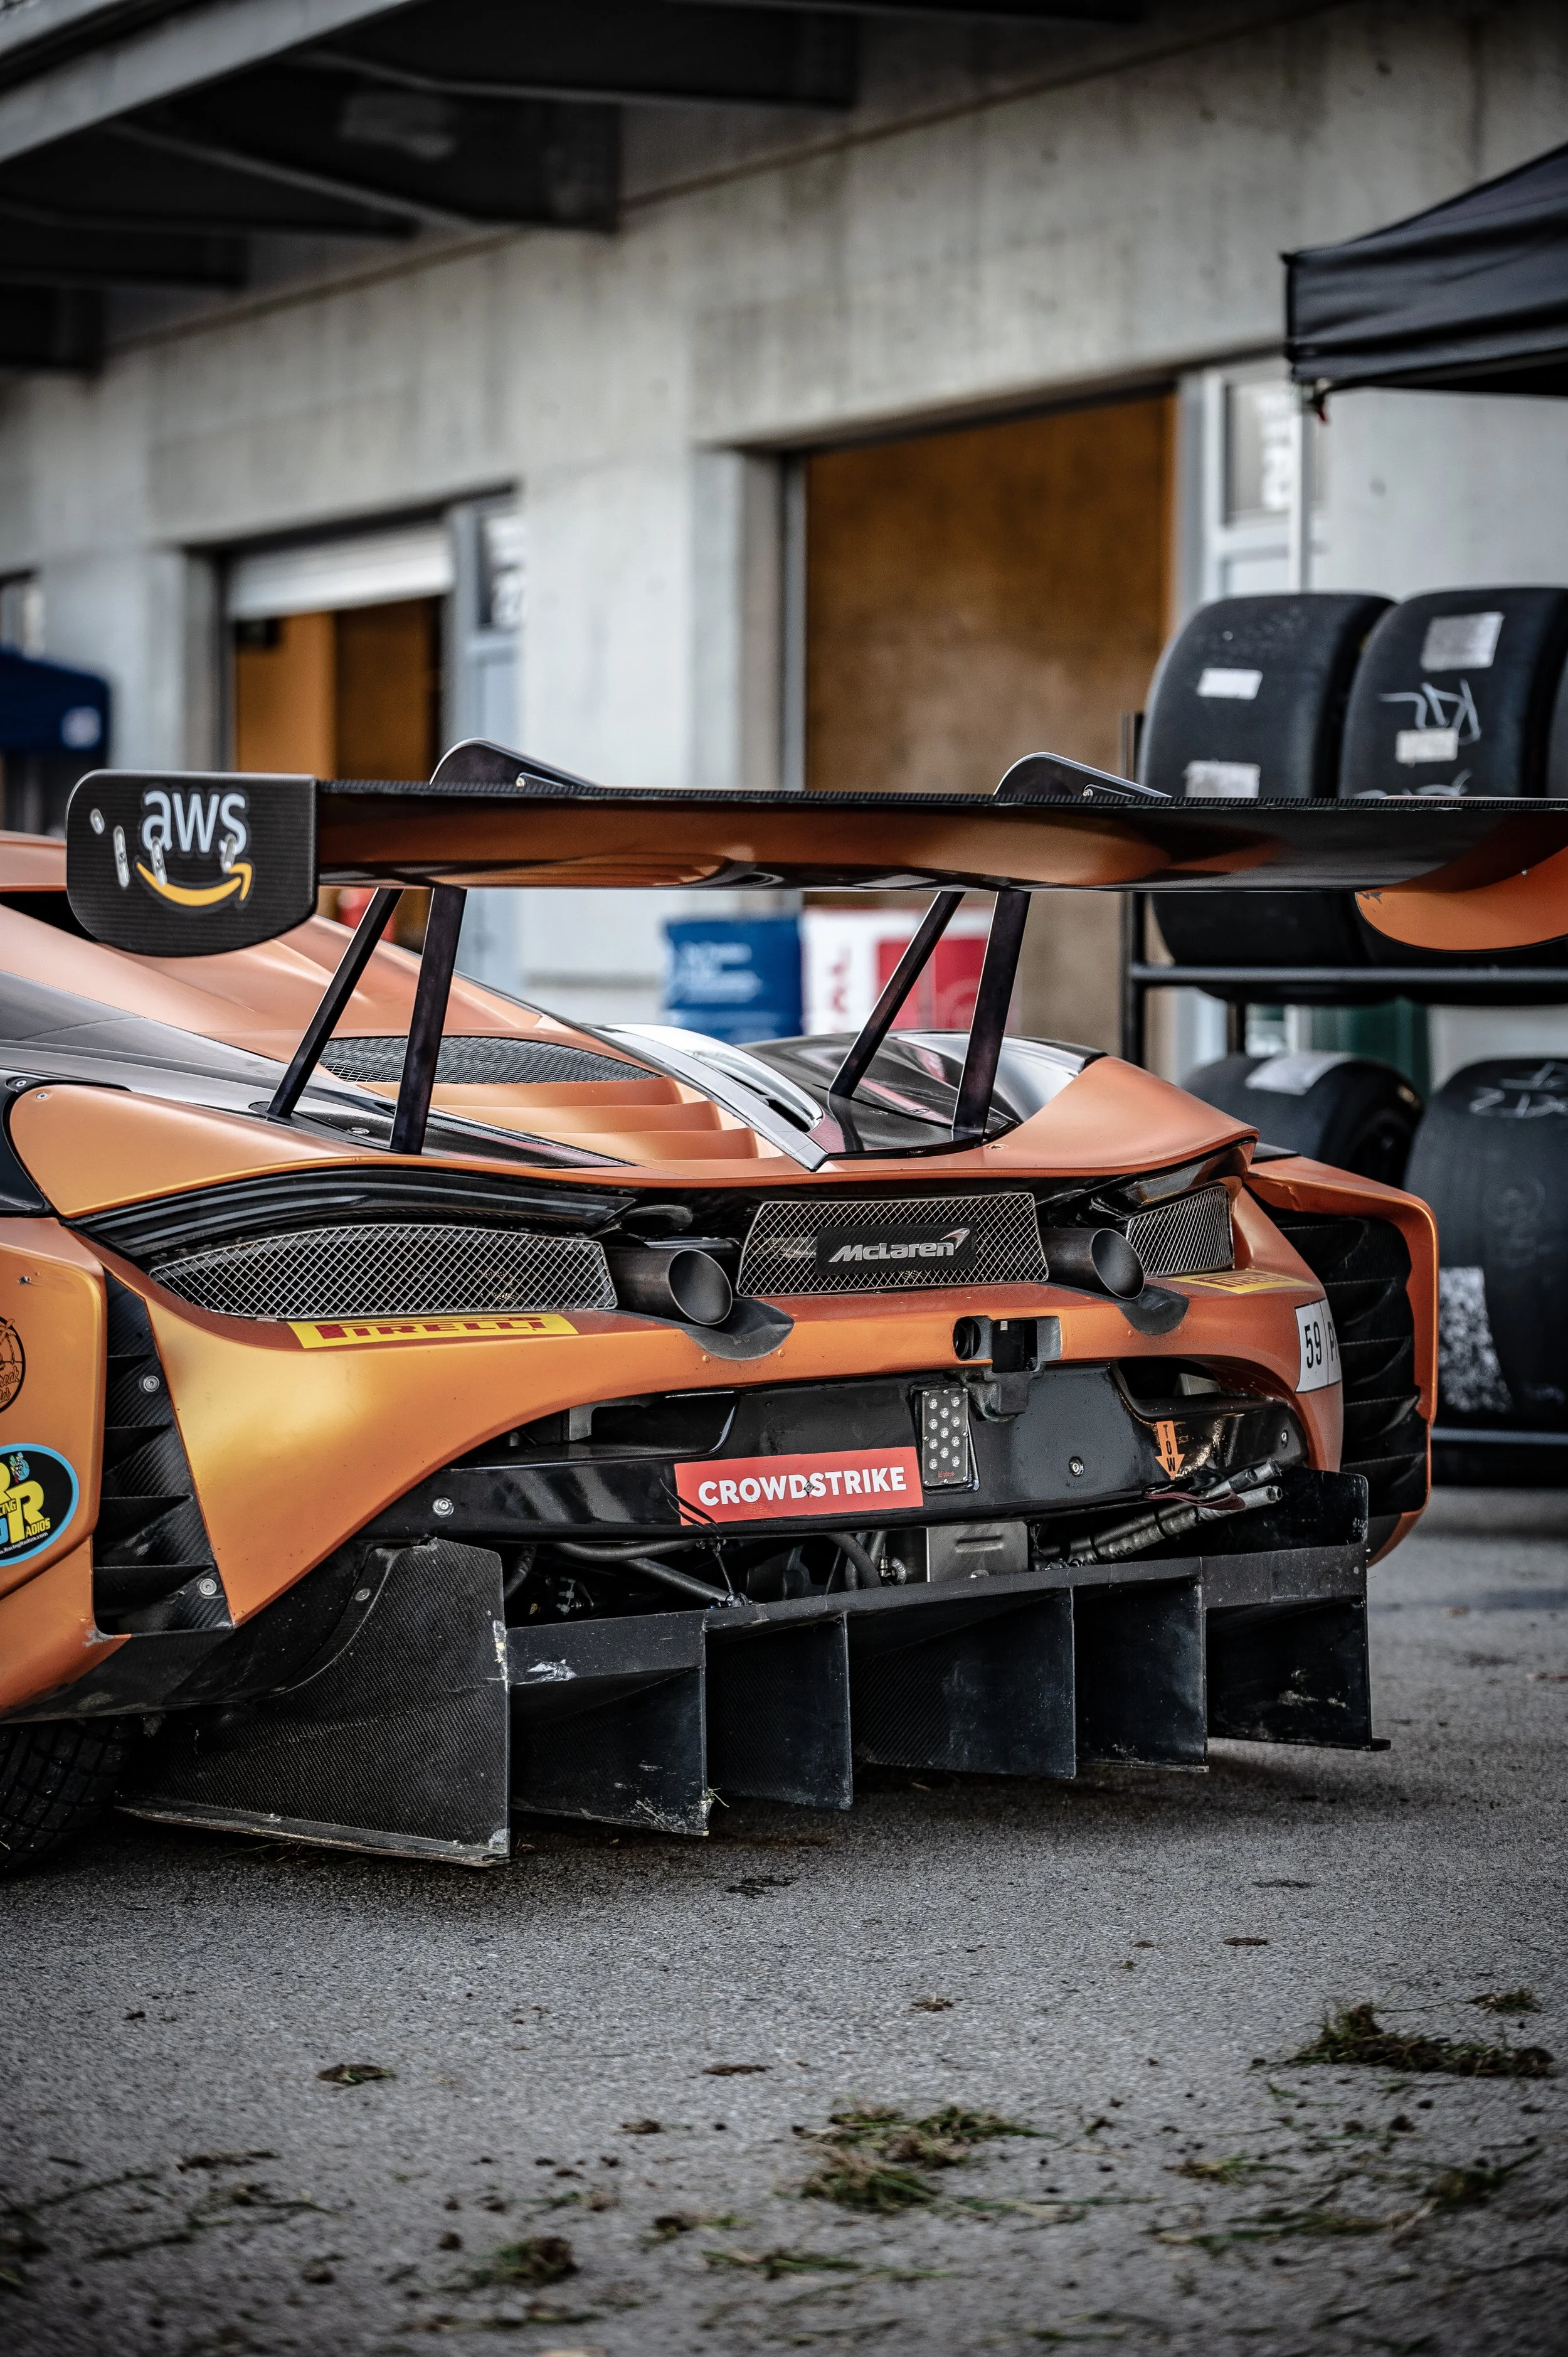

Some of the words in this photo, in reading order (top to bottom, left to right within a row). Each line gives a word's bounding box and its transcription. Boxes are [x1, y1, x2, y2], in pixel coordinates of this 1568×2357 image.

[142, 790, 247, 856] aws
[829, 1242, 955, 1263] McLaren
[314, 1317, 548, 1339] PIRELLI
[1304, 1321, 1322, 1369] 59
[1327, 1319, 1340, 1362] P
[1163, 1423, 1176, 1472] TOW
[698, 1466, 908, 1506] CROWDSTRIKE
